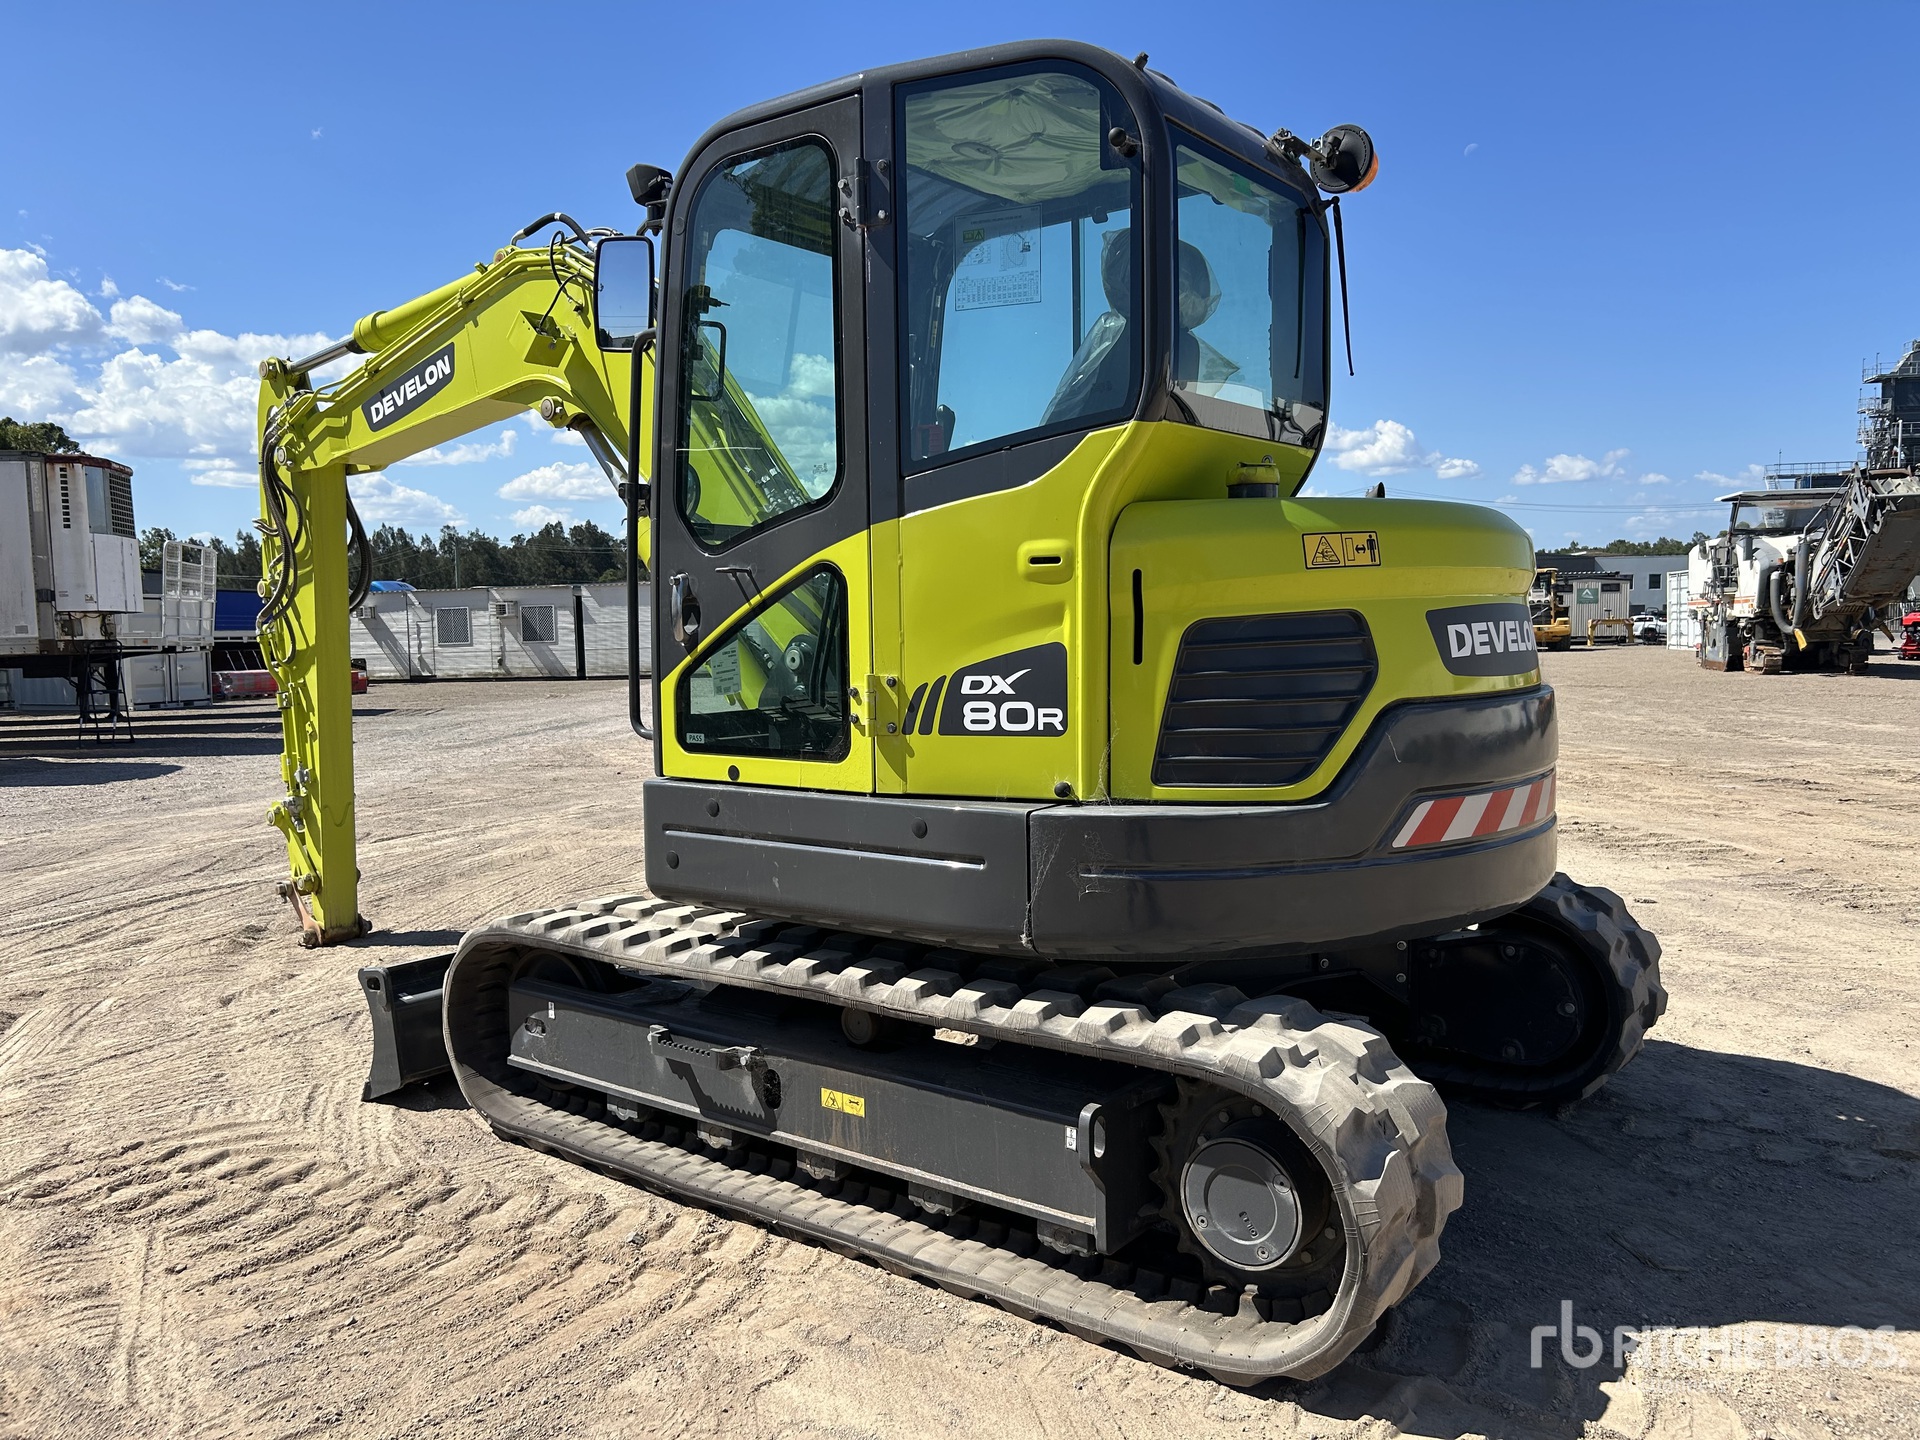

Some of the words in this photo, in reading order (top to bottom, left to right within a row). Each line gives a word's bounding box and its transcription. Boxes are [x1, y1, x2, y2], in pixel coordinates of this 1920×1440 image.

[370, 355, 451, 424] DEVELON
[961, 668, 1032, 694] DX
[963, 701, 1064, 731] 80R
[689, 734, 703, 742] PASS
